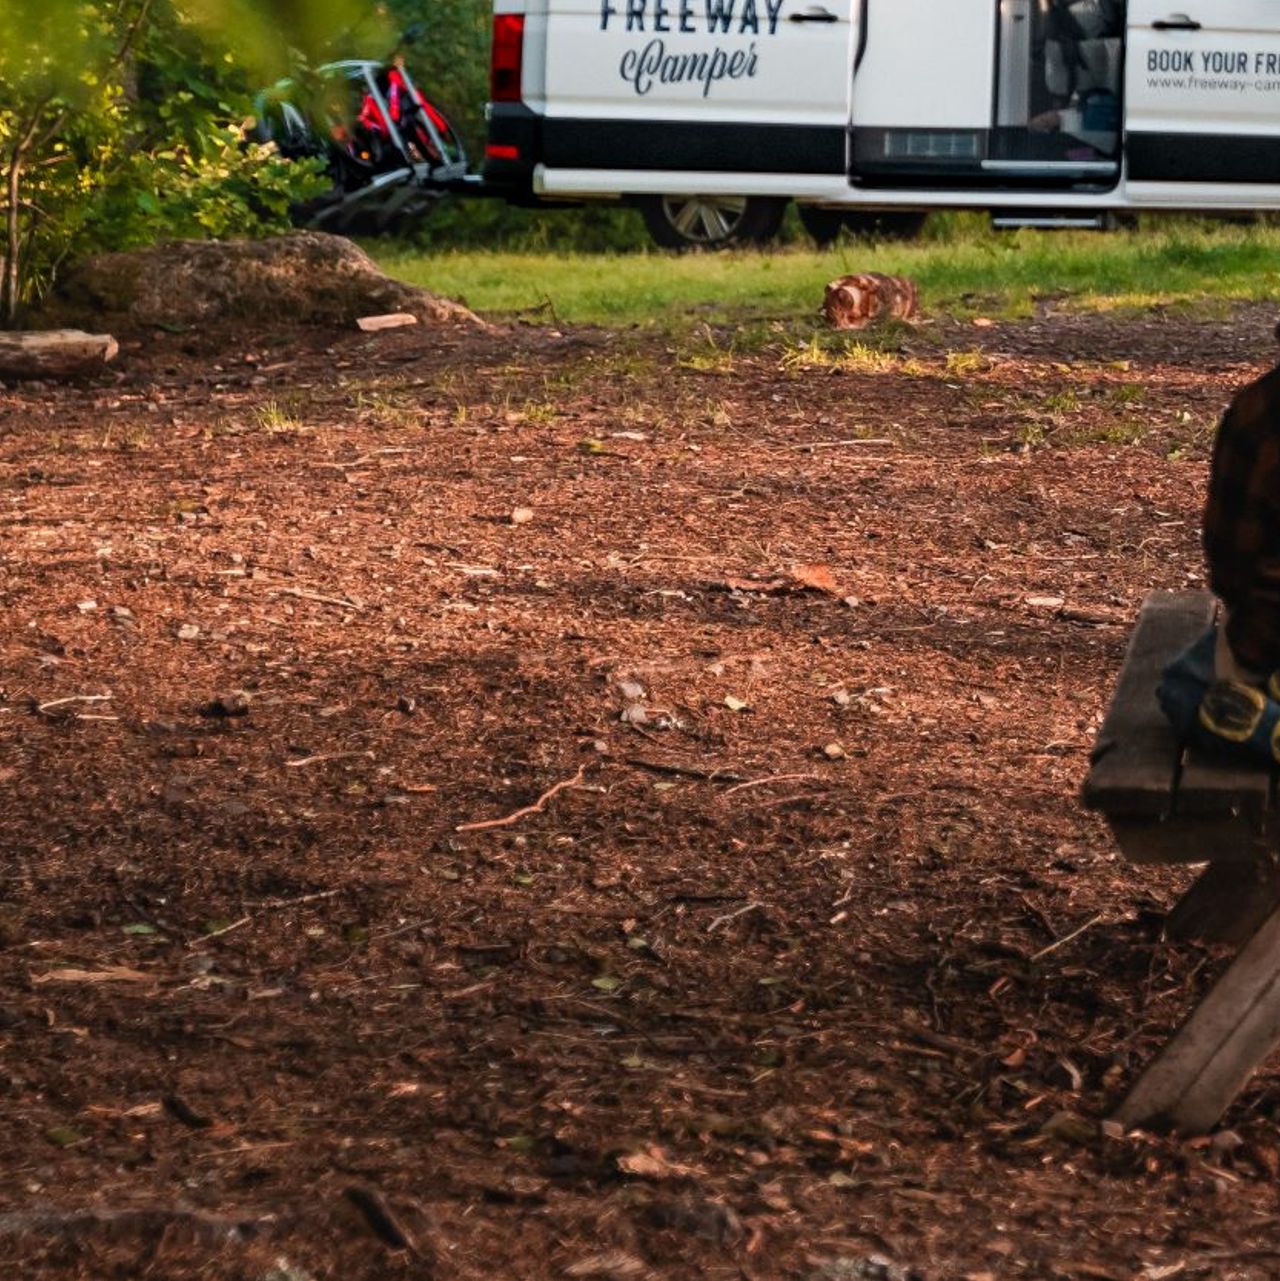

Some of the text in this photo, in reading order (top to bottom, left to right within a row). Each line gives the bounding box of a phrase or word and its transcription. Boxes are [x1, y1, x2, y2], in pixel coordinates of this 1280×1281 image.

[619, 38, 759, 98] Camper
[1146, 49, 1195, 72] BOOK
[1201, 50, 1248, 74] YOUR
